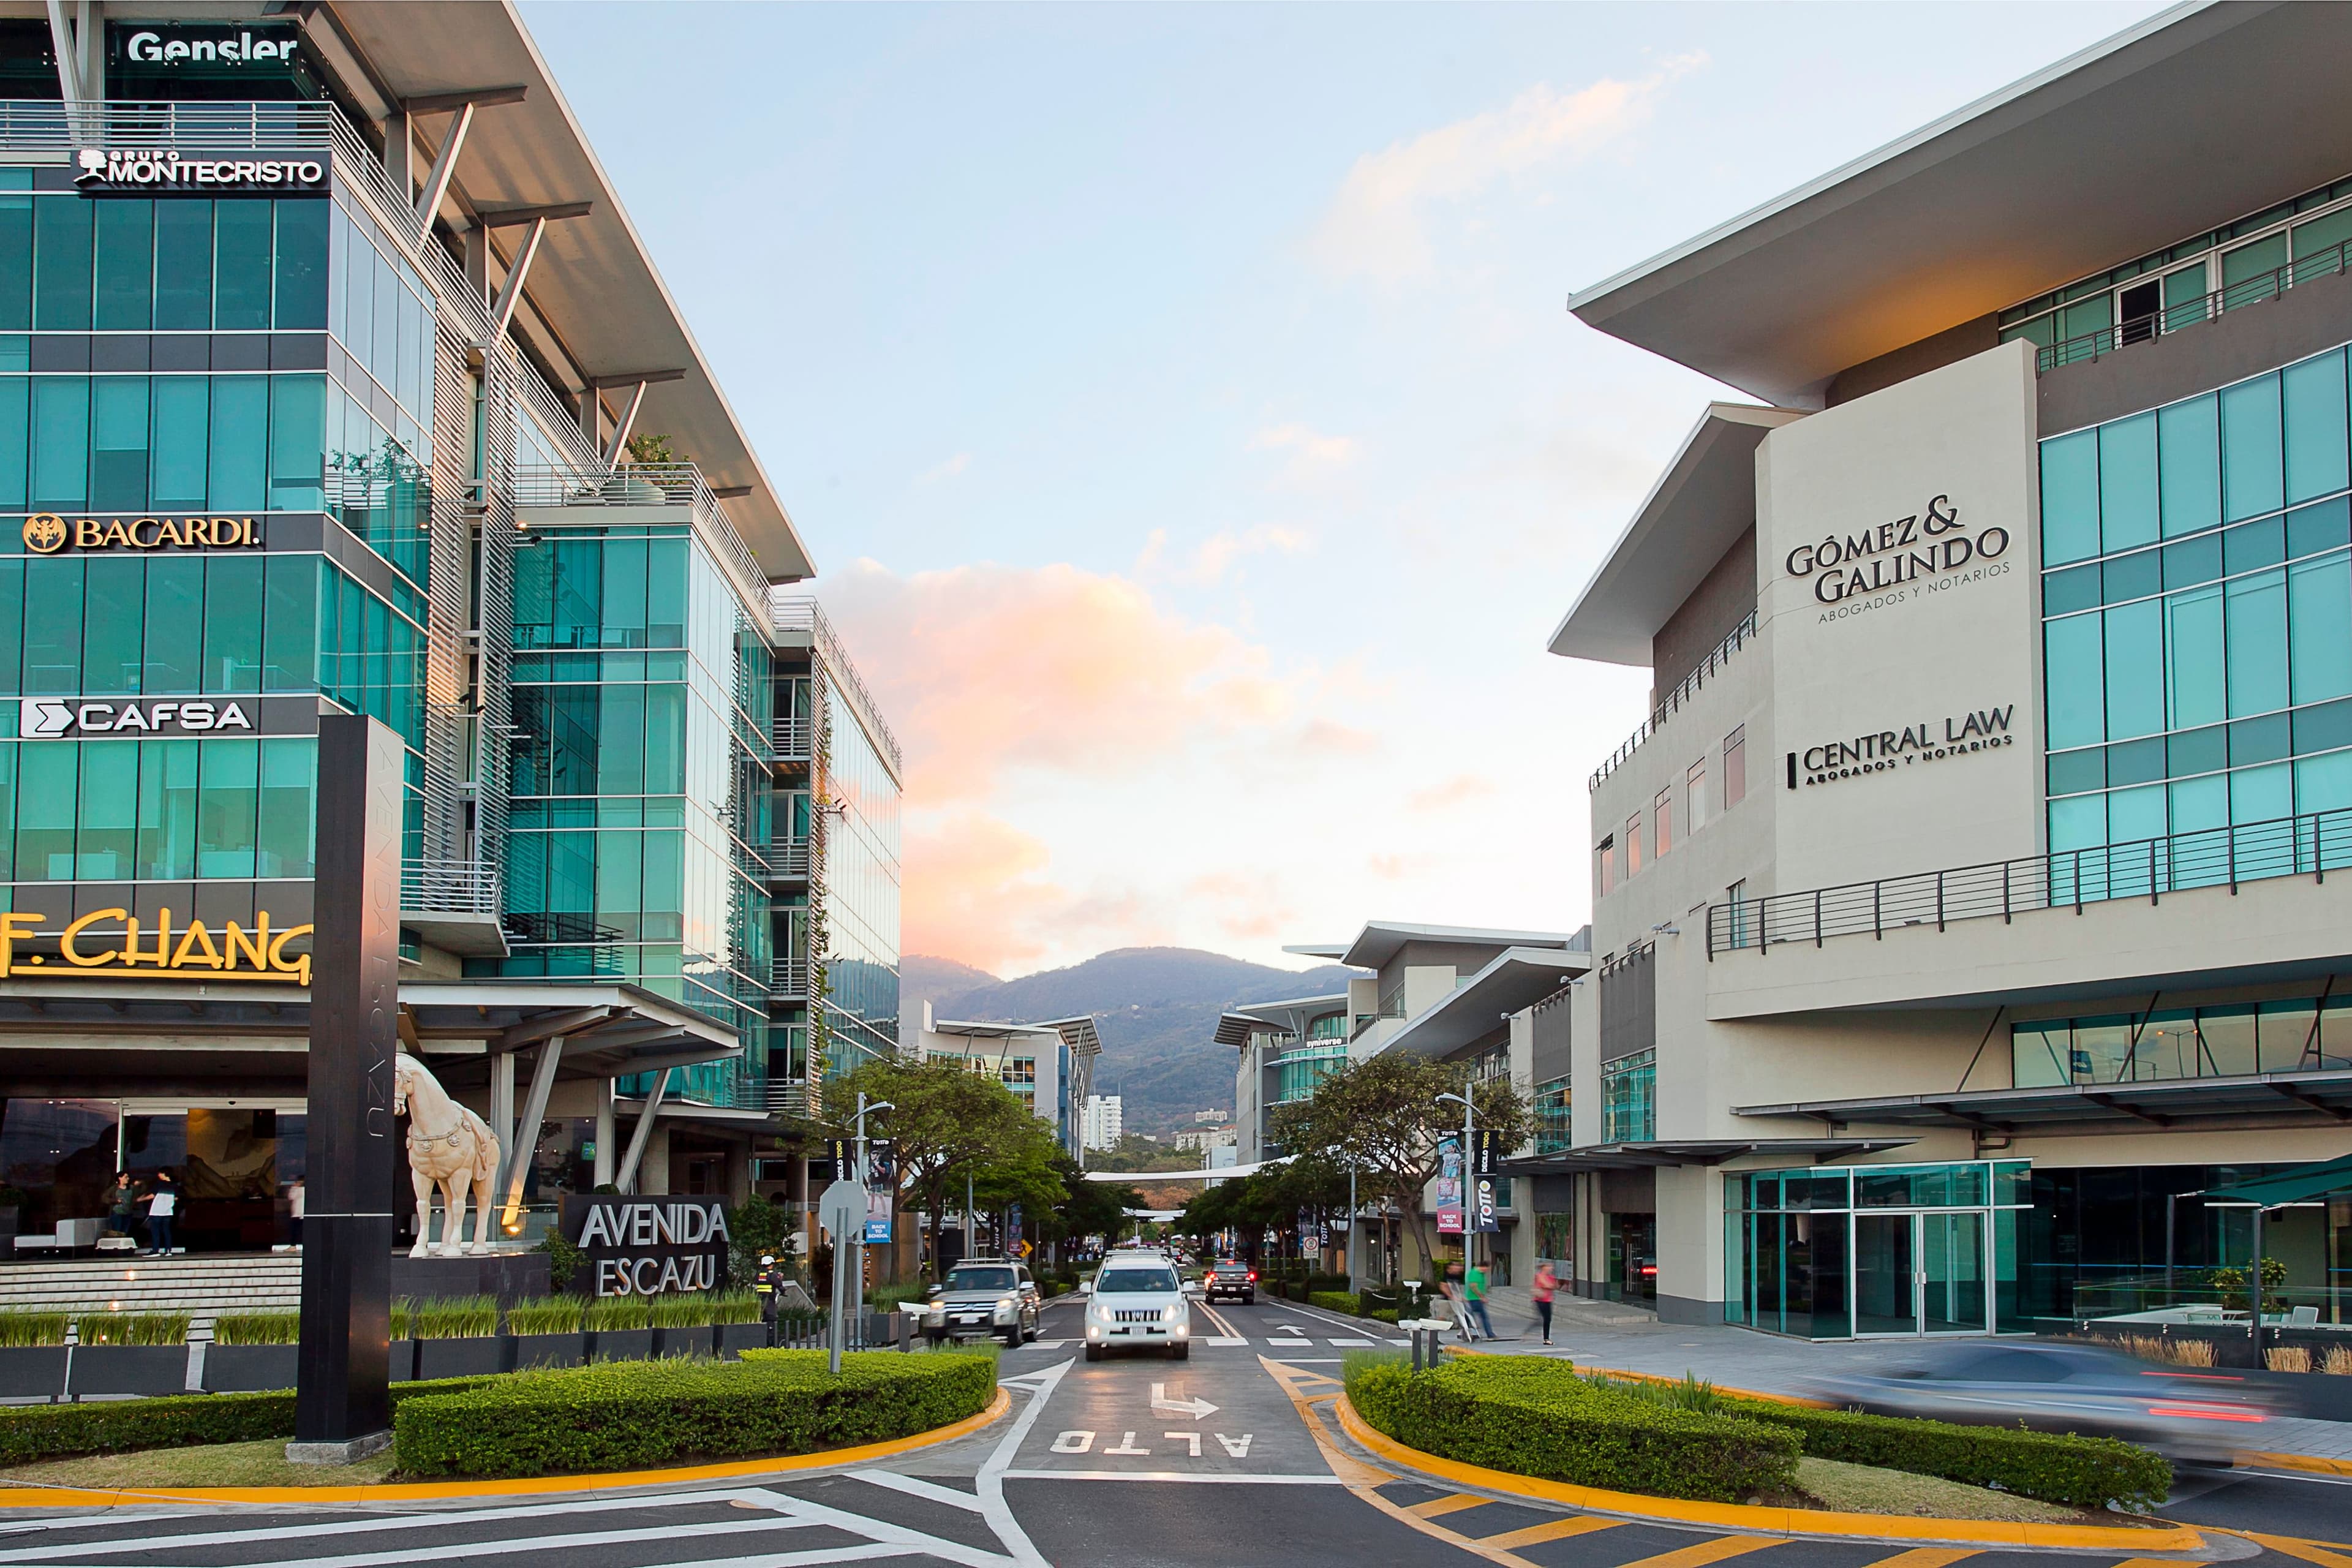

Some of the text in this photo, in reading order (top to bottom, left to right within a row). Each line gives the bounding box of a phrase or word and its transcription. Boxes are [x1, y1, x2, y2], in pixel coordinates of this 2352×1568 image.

[128, 32, 297, 61] Gensler
[108, 161, 322, 183] MONTECRISTO
[110, 151, 180, 162] GRUPO
[1923, 494, 1966, 535] &
[1815, 527, 2010, 603] GALINDO
[1818, 561, 2010, 624] ABOGADOS Y NOTARIOS
[78, 702, 251, 730] CAFSA
[1804, 704, 2013, 771] CENTRAL LAW
[1806, 735, 2013, 785] ABOGADOS Y NOTARIOS
[1306, 1038, 1342, 1049] syniverse
[1478, 1180, 1493, 1226] TOTTO
[578, 1204, 729, 1248] AVENIDA
[596, 1254, 715, 1297] ESCAZU
[1049, 1431, 1253, 1457] ALTO
